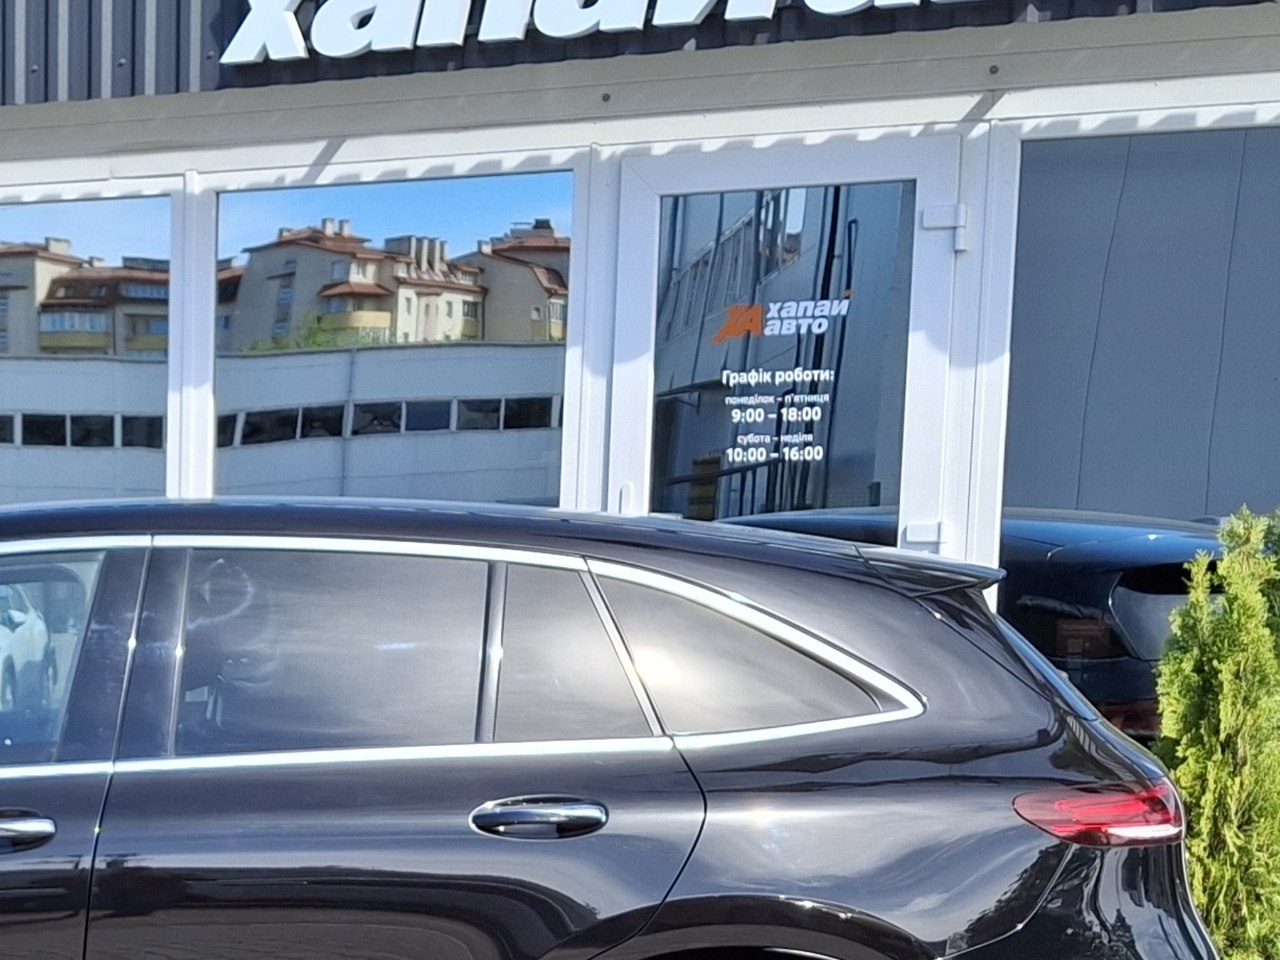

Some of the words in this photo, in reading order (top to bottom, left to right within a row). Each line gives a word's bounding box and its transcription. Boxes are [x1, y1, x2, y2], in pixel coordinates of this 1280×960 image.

[763, 316, 830, 336] авто
[722, 368, 772, 387] Графік
[775, 367, 835, 386] роботи:
[731, 408, 765, 423] 9:00
[780, 406, 822, 422] 18:00
[737, 433, 771, 446] субота
[780, 432, 814, 444] неділя
[726, 447, 767, 462] 10:00
[782, 445, 824, 461] 16:00
